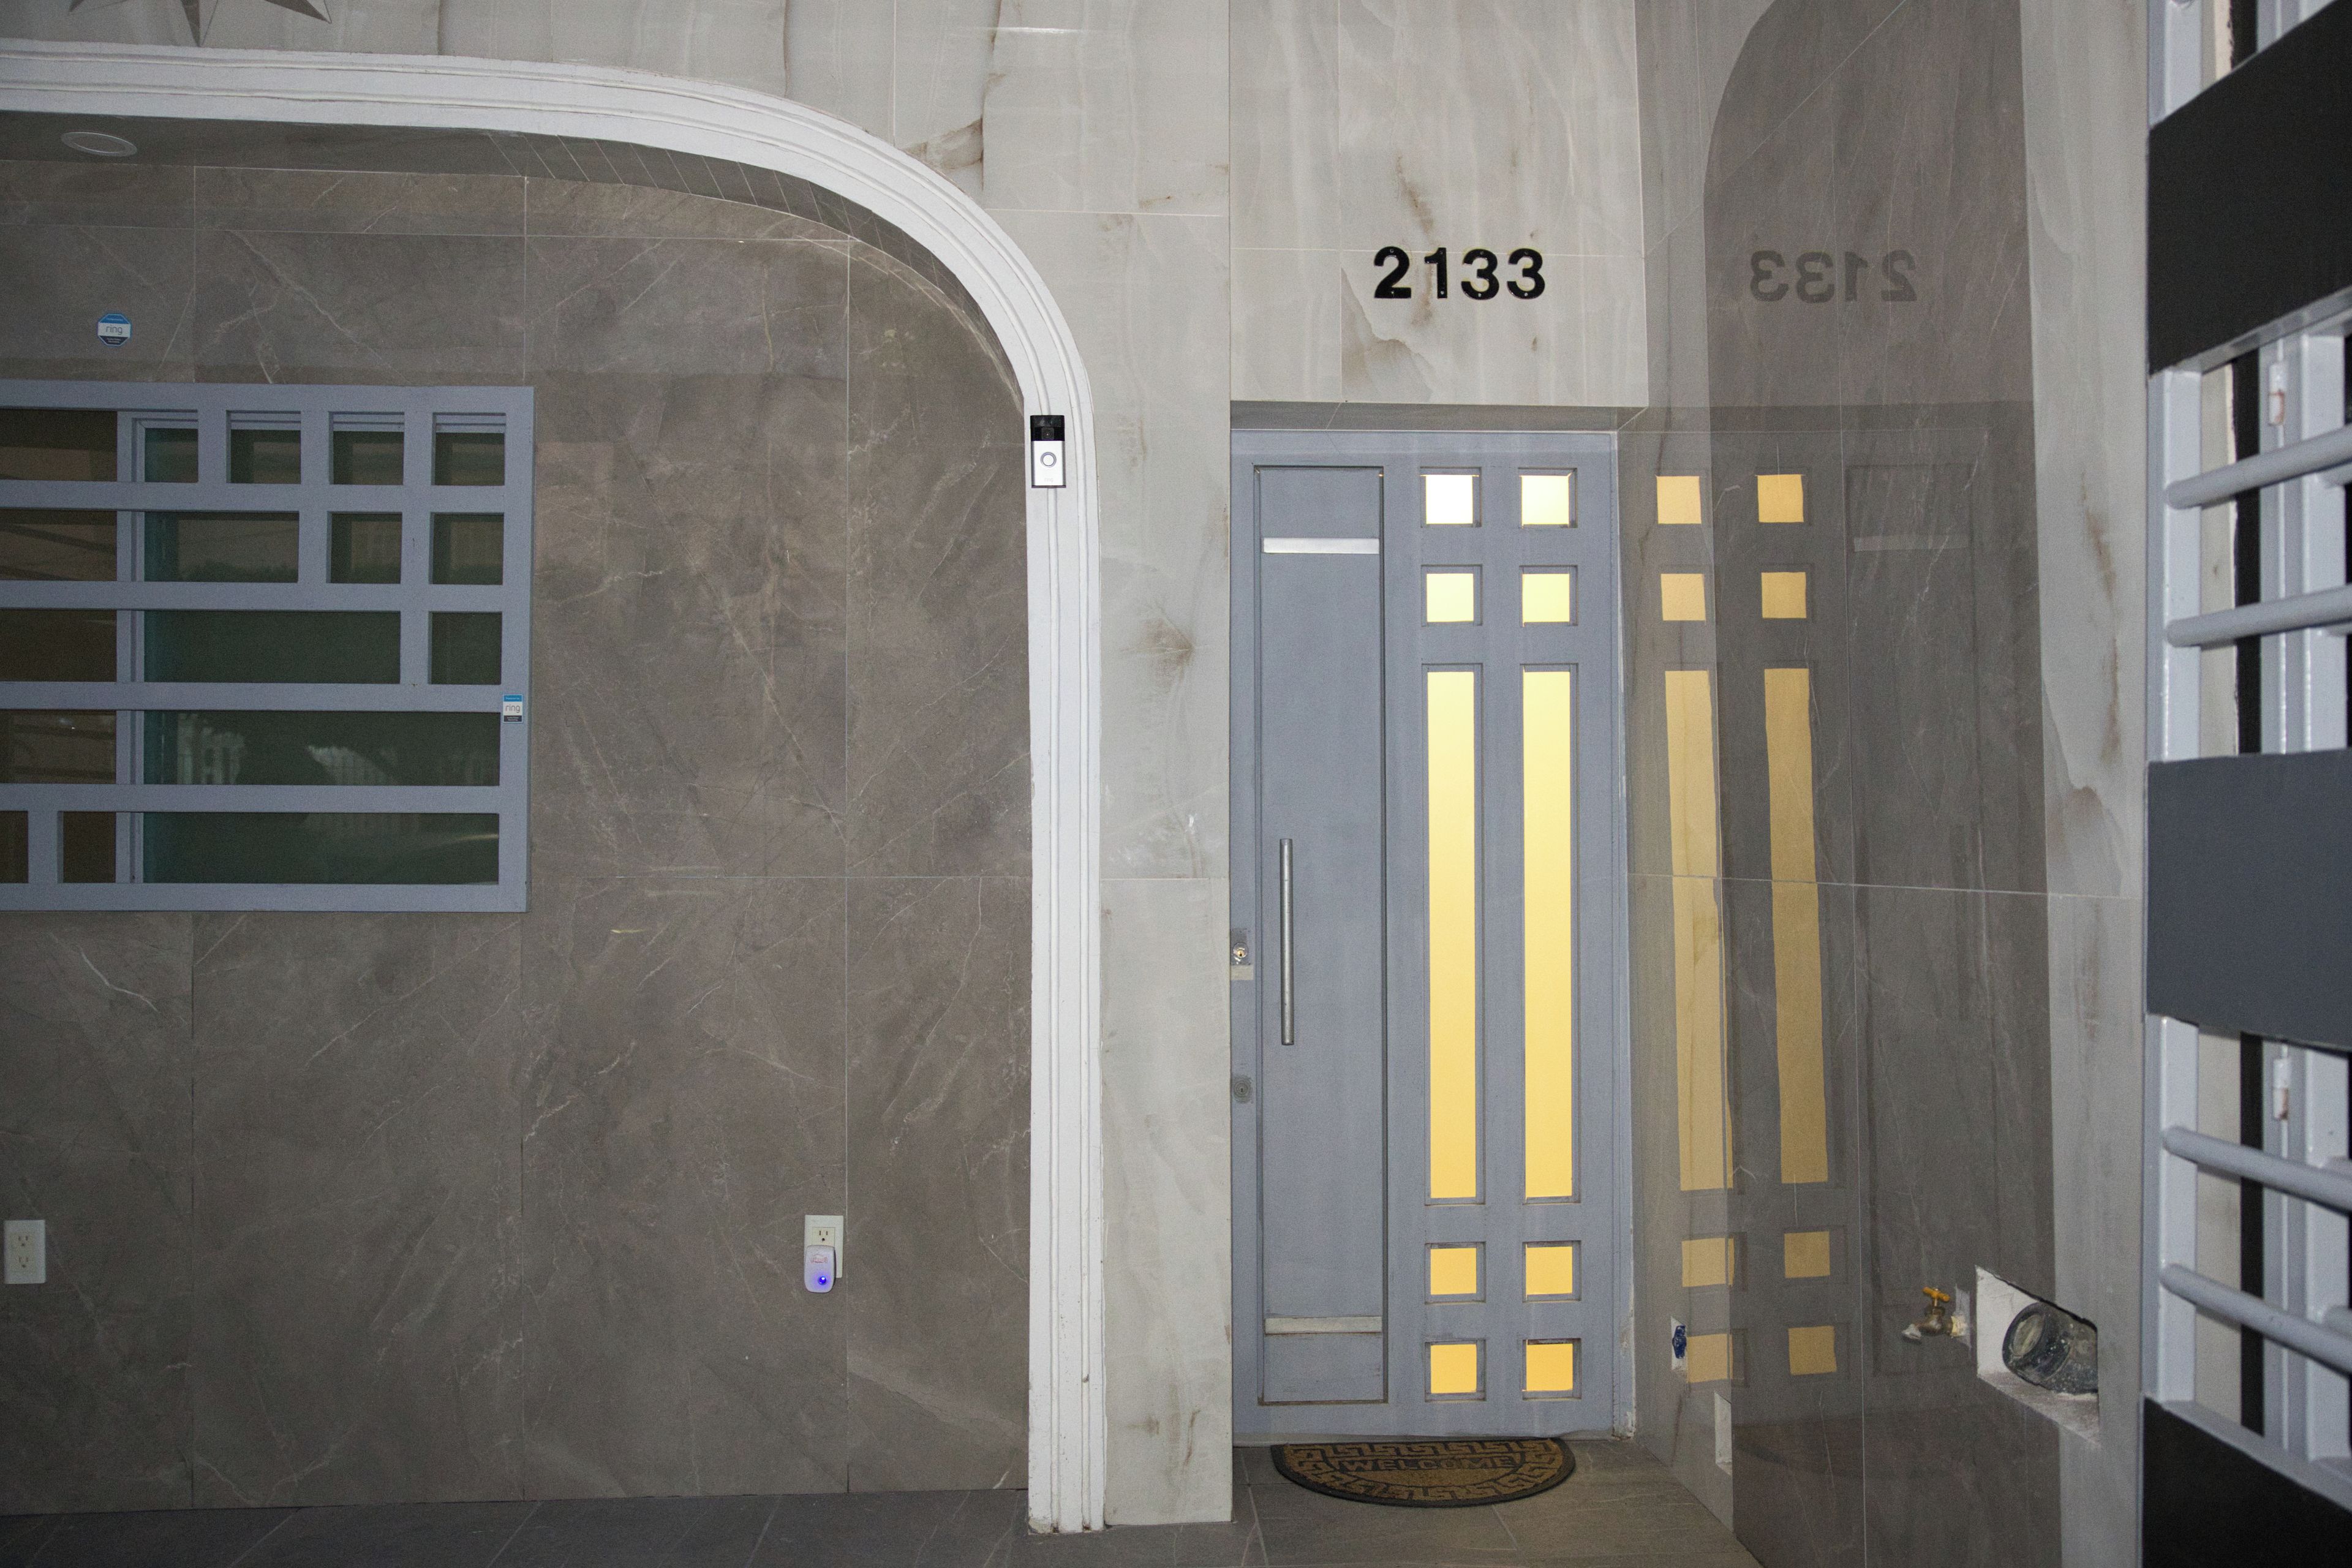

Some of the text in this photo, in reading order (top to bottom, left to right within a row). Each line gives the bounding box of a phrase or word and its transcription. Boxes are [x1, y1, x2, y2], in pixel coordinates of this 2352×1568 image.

[1373, 247, 1545, 300] 2133
[106, 325, 123, 335] ring
[505, 704, 520, 713] ring
[1340, 1455, 1516, 1471] WELCOME
